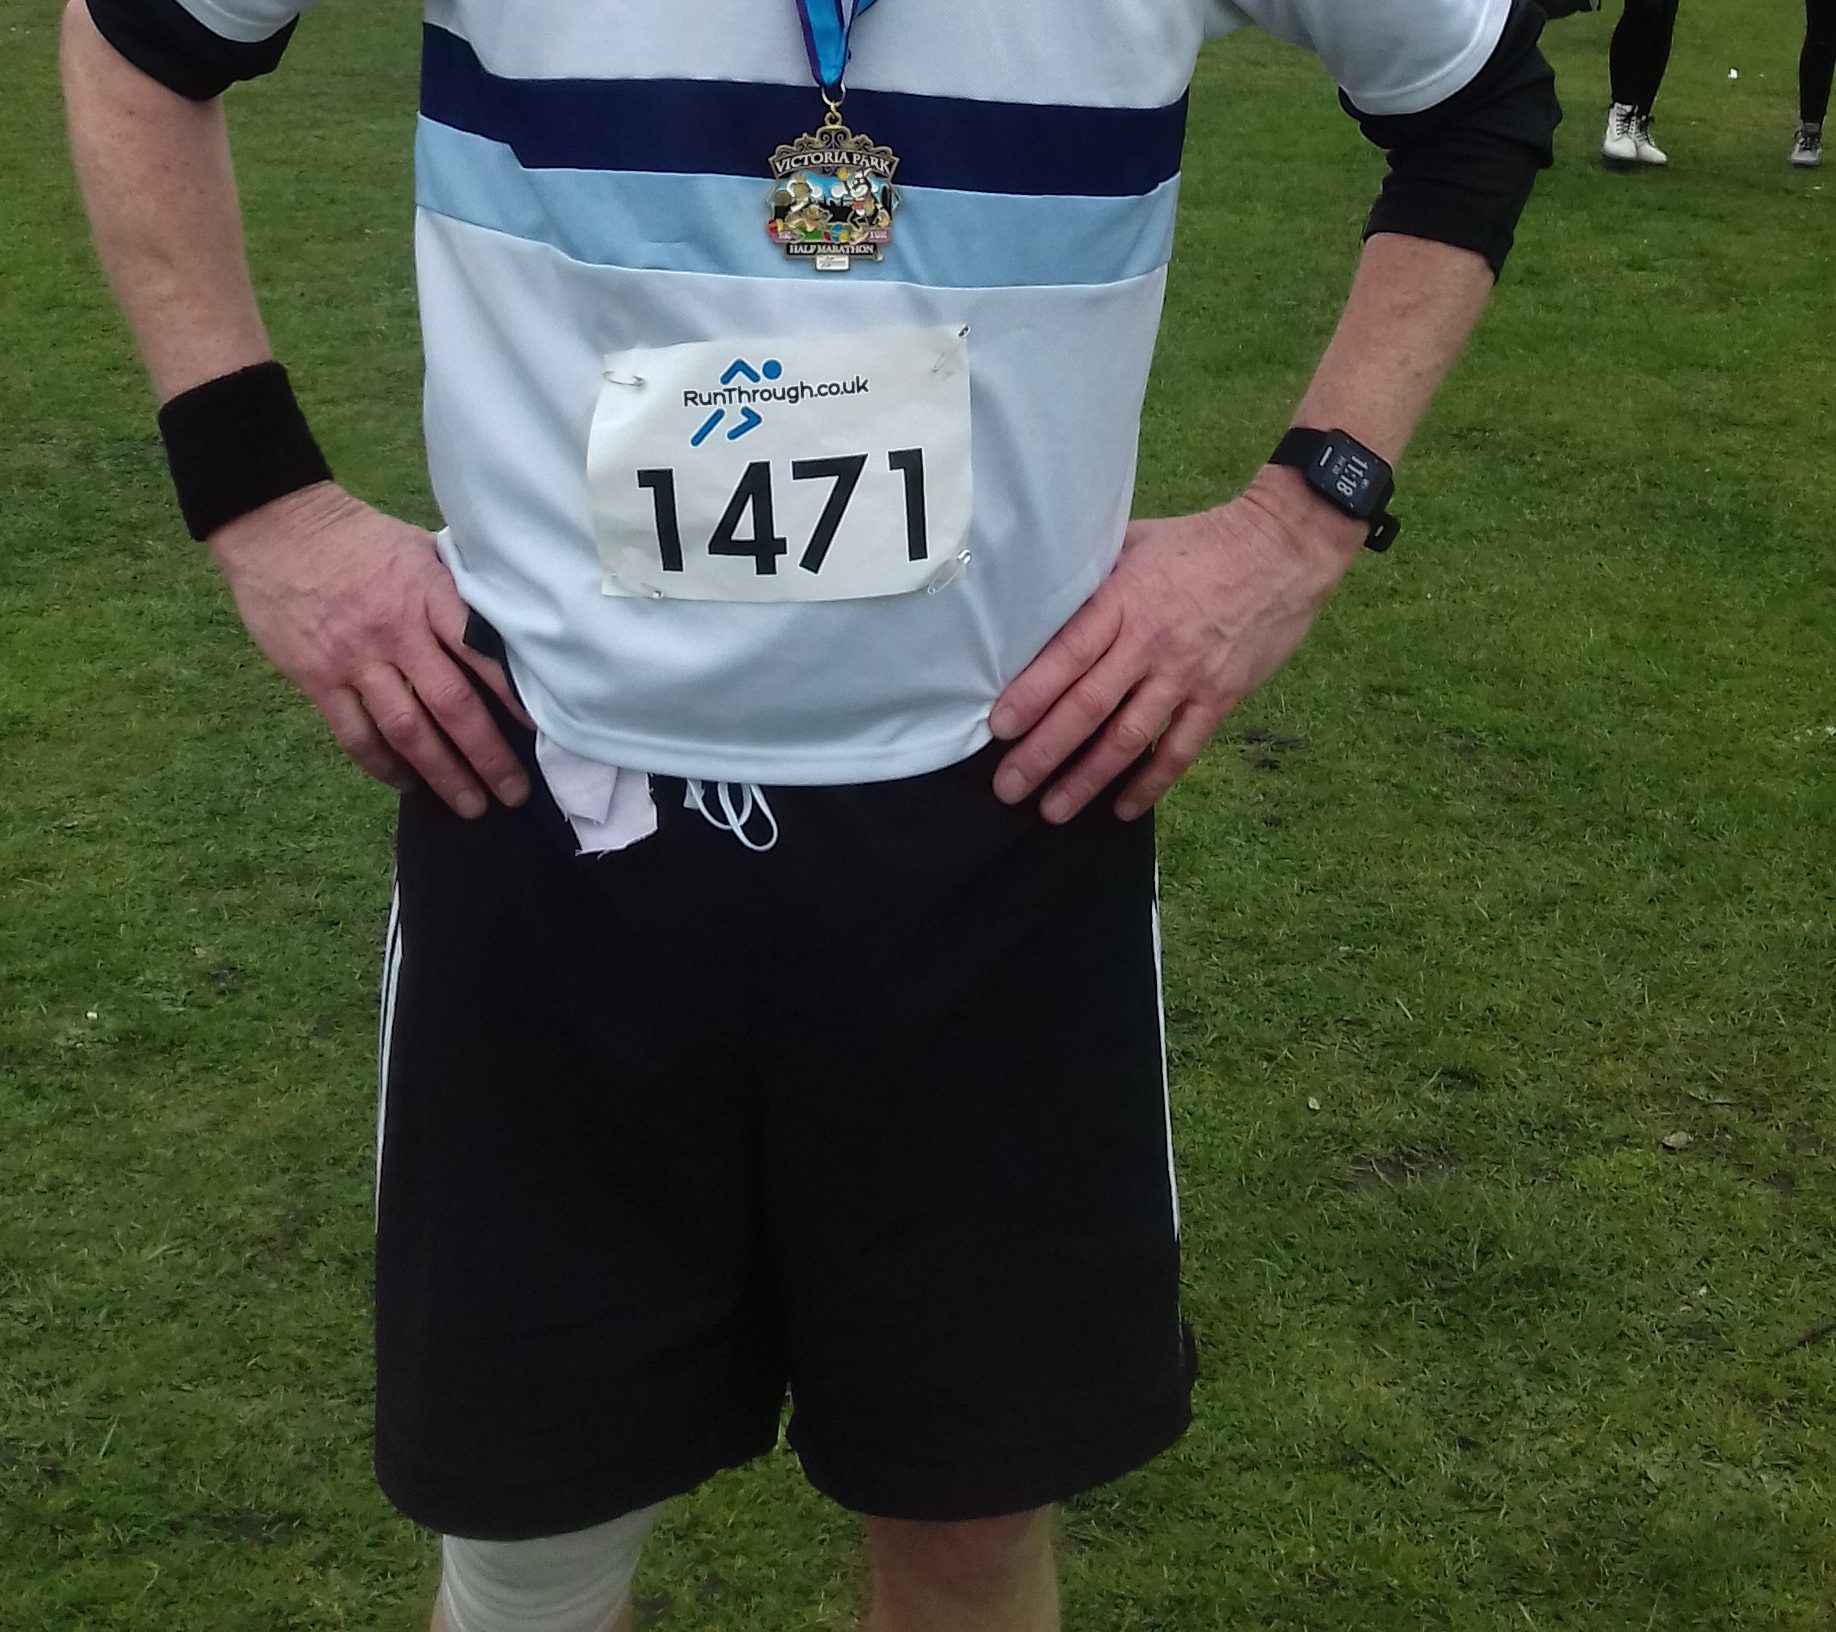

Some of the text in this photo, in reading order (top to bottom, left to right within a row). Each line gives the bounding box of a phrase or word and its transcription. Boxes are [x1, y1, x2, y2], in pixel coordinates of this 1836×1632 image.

[775, 151, 889, 173] VICTORIA PARK
[789, 245, 874, 254] HALF MARATHON
[684, 376, 868, 407] RunThrough.co.uk
[1336, 455, 1368, 496] 11:18
[637, 448, 927, 575] 1471
